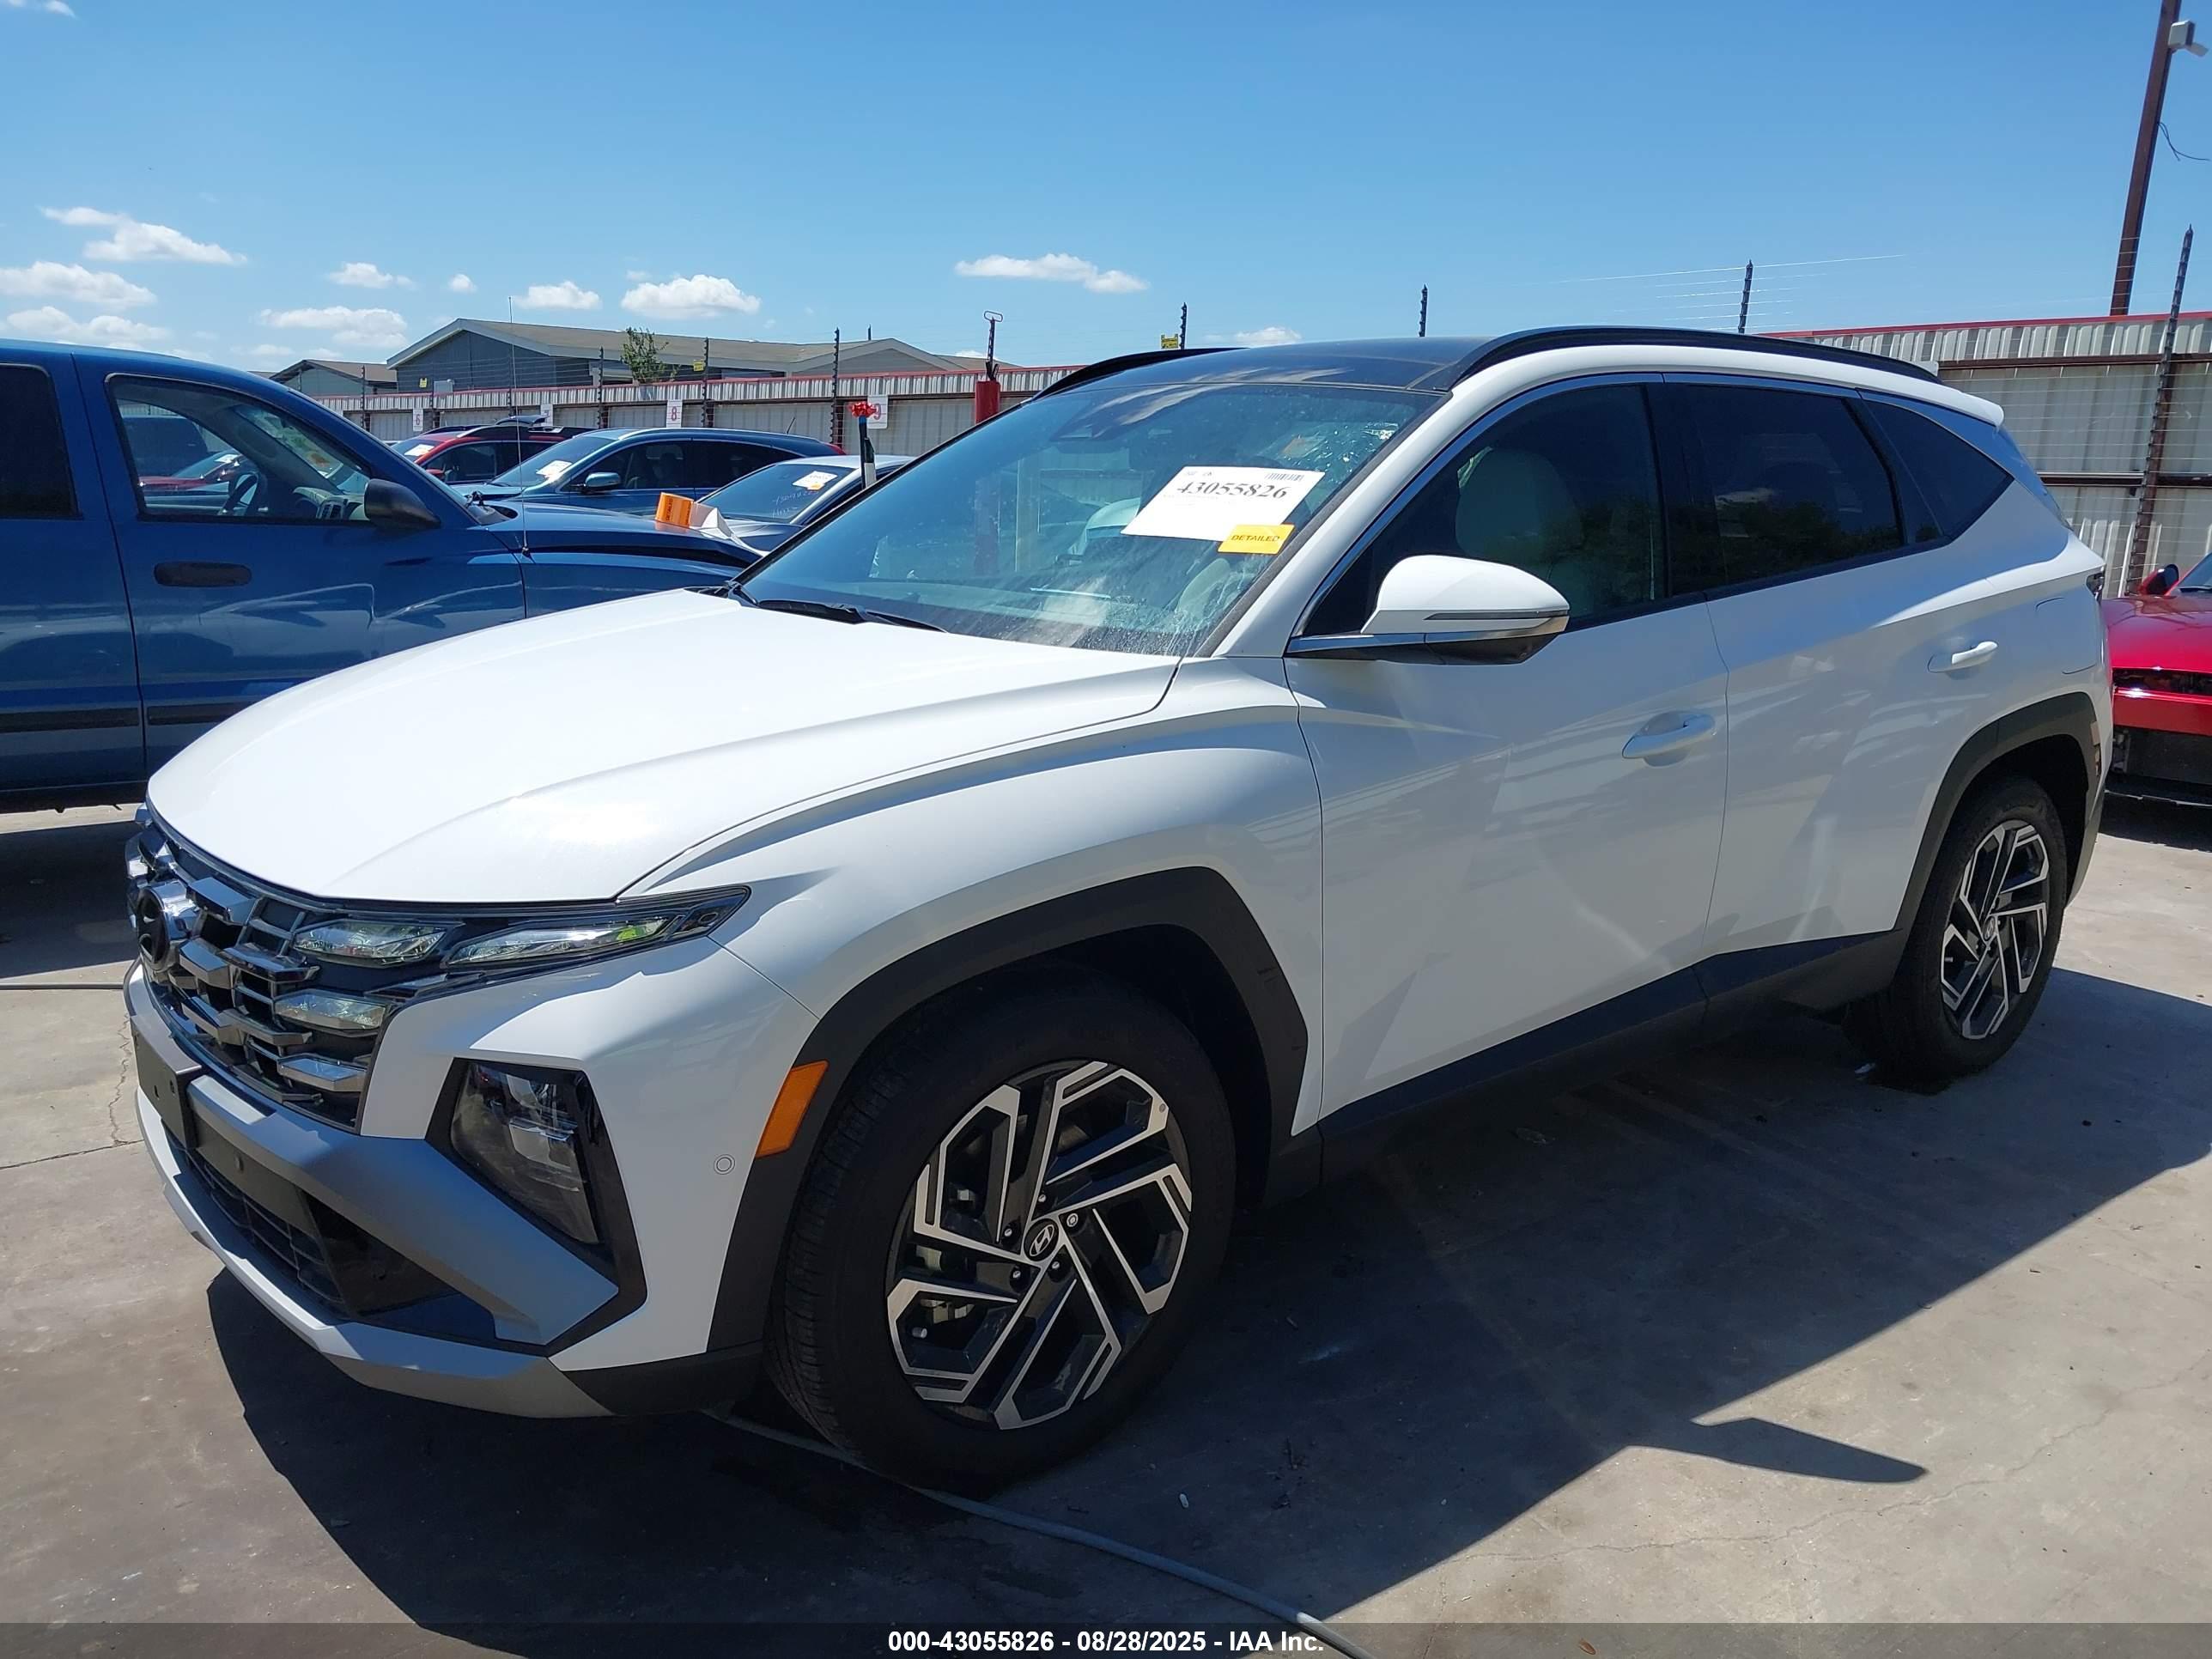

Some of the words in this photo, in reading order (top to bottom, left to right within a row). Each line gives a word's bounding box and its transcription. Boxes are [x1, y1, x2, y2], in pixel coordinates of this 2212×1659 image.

[416, 414, 421, 426] 6
[671, 406, 678, 422] 8
[1176, 481, 1291, 499] 43055826
